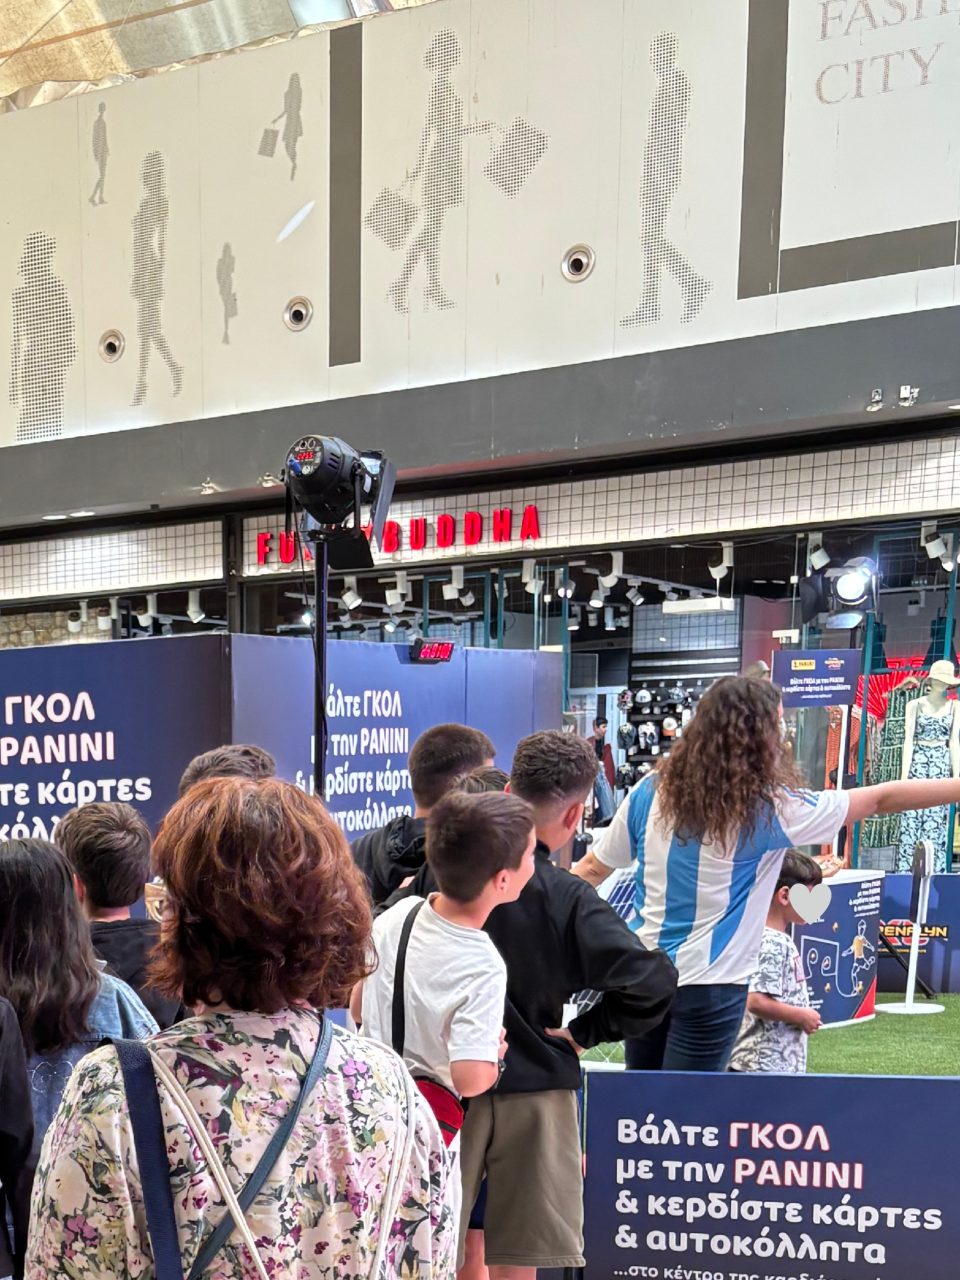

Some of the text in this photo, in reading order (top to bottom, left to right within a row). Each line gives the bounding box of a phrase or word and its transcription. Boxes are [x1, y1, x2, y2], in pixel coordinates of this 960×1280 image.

[816, 42, 944, 105] CITY
[256, 504, 541, 566] FUBUDDHA
[4, 691, 96, 726] ΓΚΟΛ
[326, 683, 402, 718] άλτε ΓΚΟΛ
[0, 731, 115, 765] PANINI
[331, 734, 358, 756] την
[360, 728, 409, 755] PANINI
[37, 769, 152, 807] κάρτες
[310, 761, 373, 802] ρδίστε
[617, 1113, 830, 1151] Βάλτε ΓΚΟΛ
[616, 1158, 864, 1189] με την PANINI
[615, 1188, 942, 1232] & κερδίστε κάρτες
[615, 1224, 886, 1264] & αυτοκόλλητα
